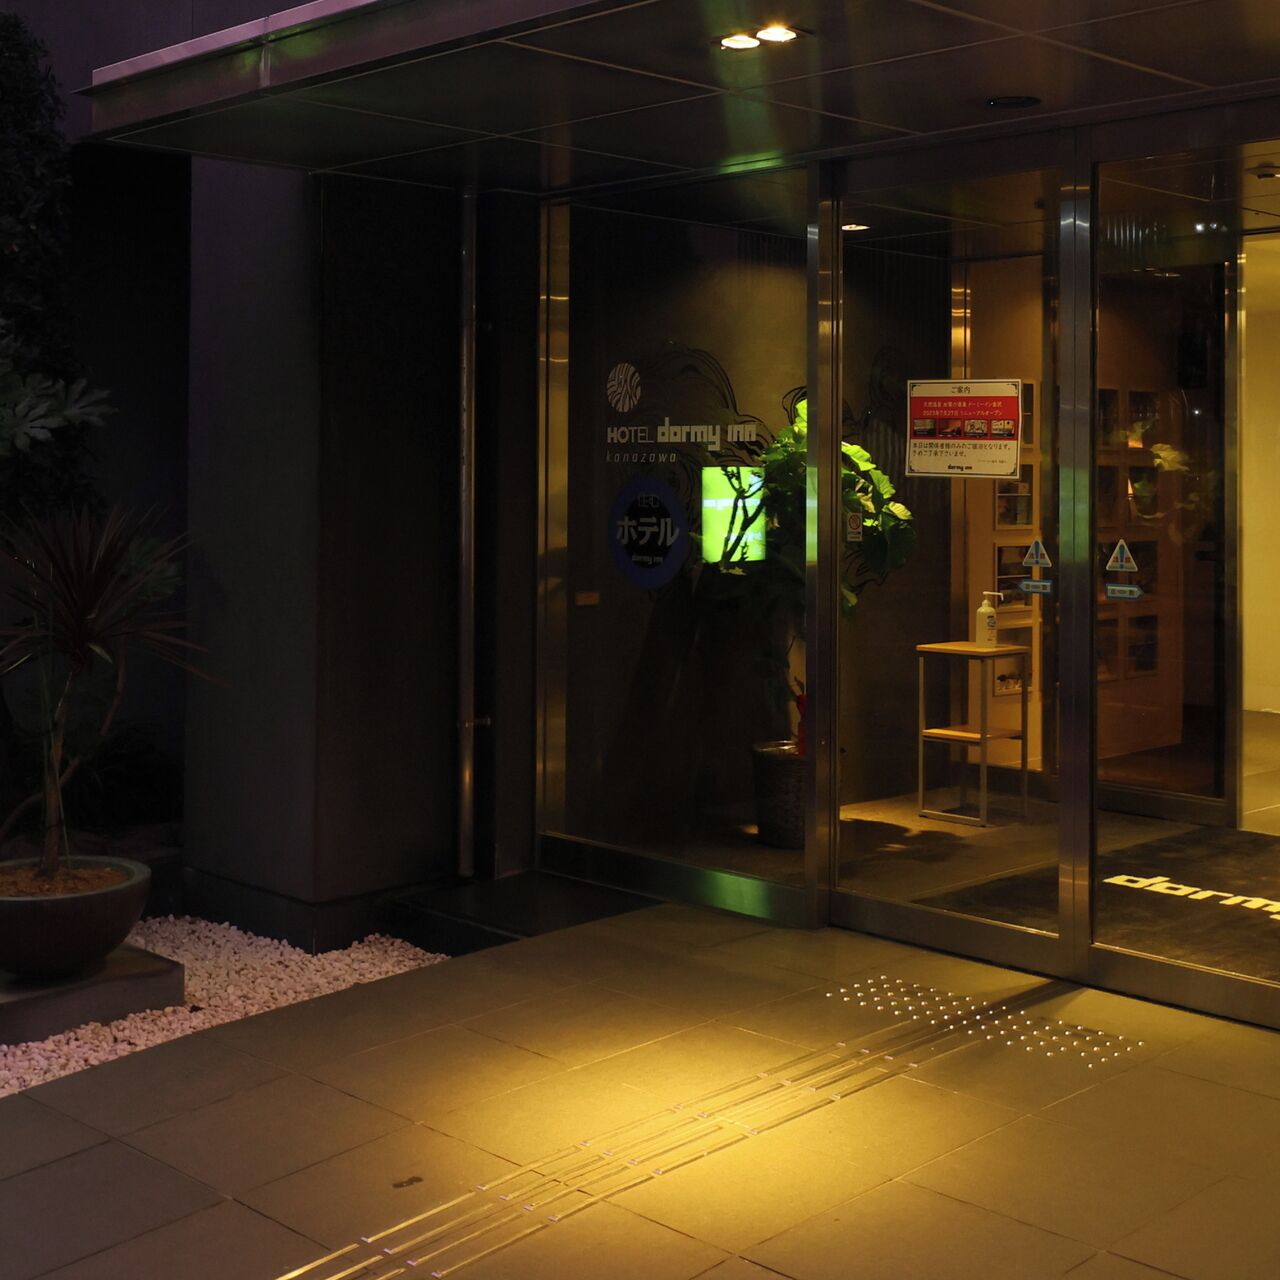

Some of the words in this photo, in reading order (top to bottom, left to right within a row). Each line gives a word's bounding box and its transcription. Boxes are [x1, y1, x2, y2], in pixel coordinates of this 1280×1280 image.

[607, 426, 655, 443] HOTEL
[657, 416, 721, 452] dormy
[727, 423, 757, 442] inn
[605, 449, 679, 463] kanazawa
[615, 515, 680, 547] ホテル
